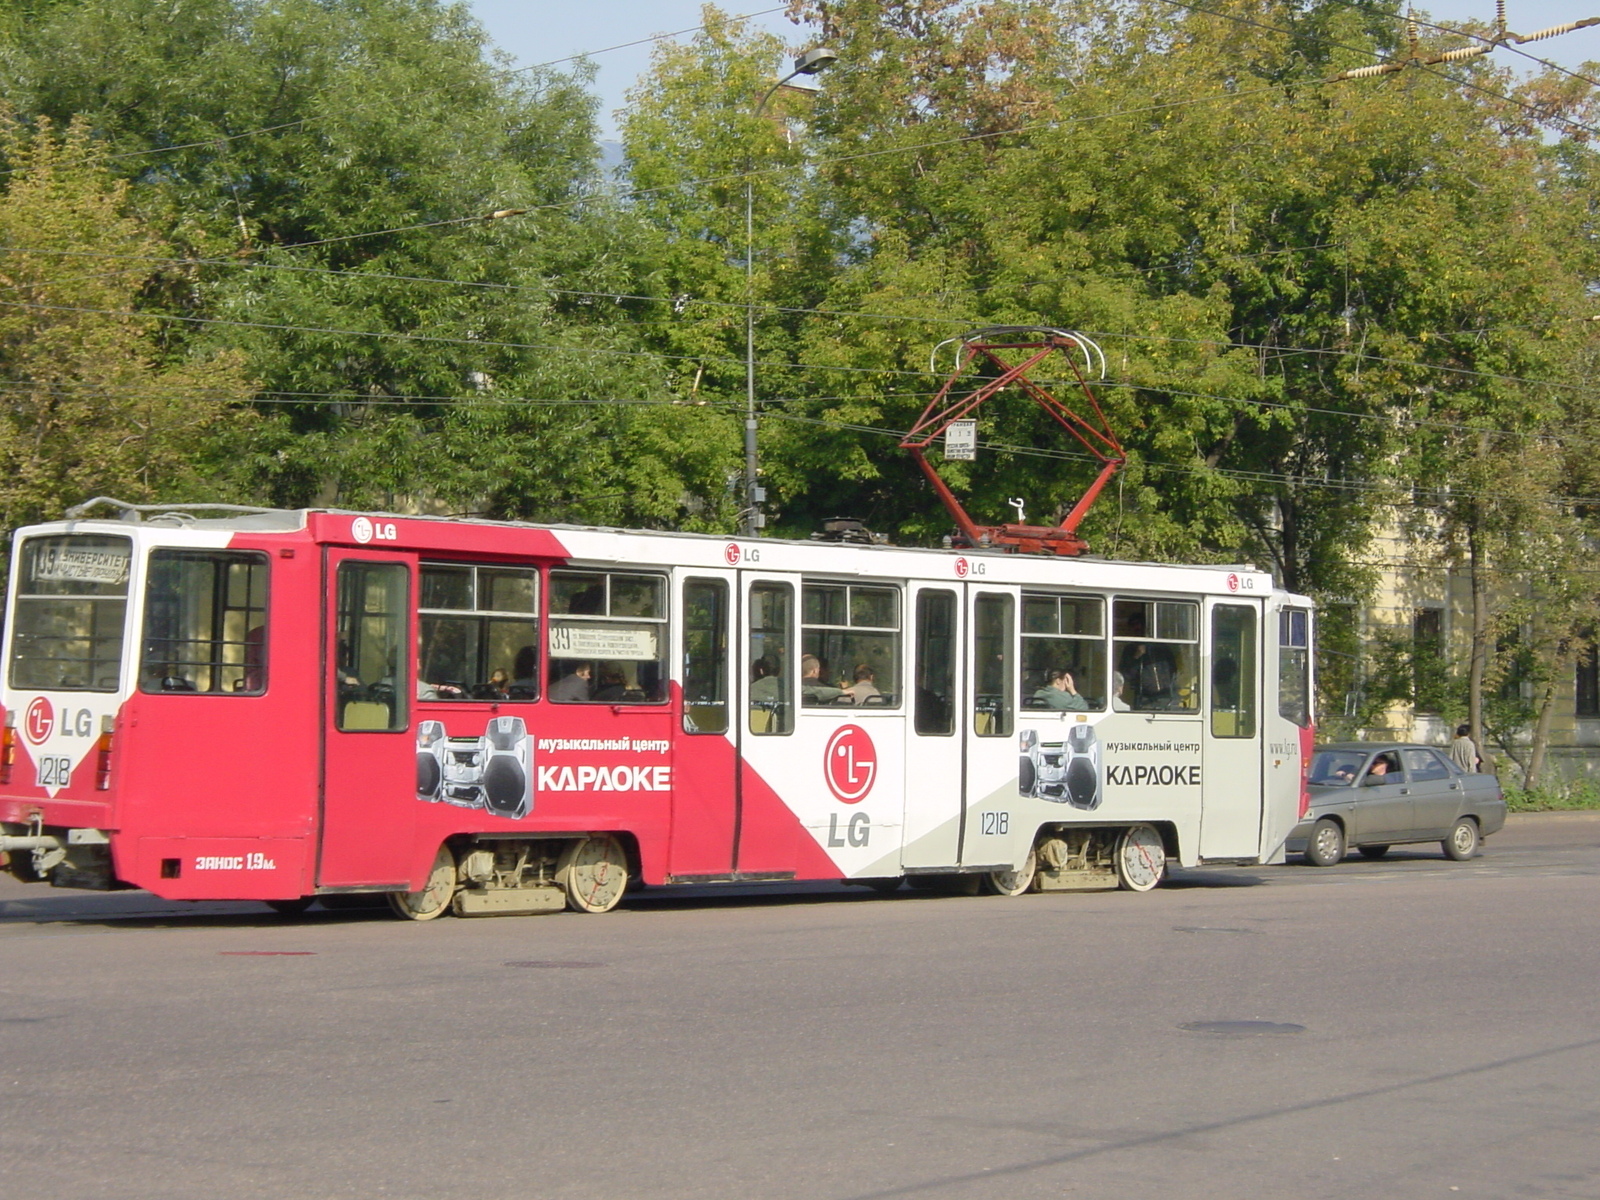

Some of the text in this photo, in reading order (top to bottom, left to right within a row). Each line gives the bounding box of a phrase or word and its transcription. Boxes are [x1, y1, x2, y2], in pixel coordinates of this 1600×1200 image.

[375, 523, 397, 540] LG
[744, 548, 760, 562] LG
[971, 562, 986, 575] LG
[1241, 578, 1254, 589] LG
[551, 627, 571, 650] 39
[60, 708, 93, 738] LG
[538, 736, 670, 754] музыкальный центр
[1106, 740, 1200, 754] музыкальный центр
[38, 757, 71, 786] 1218
[538, 765, 671, 792] КАРАОКЕ
[1106, 765, 1201, 786] КАРАОКЕ
[827, 811, 871, 848] LG
[981, 812, 1009, 835] 1218
[195, 856, 243, 870] ЗАНОС
